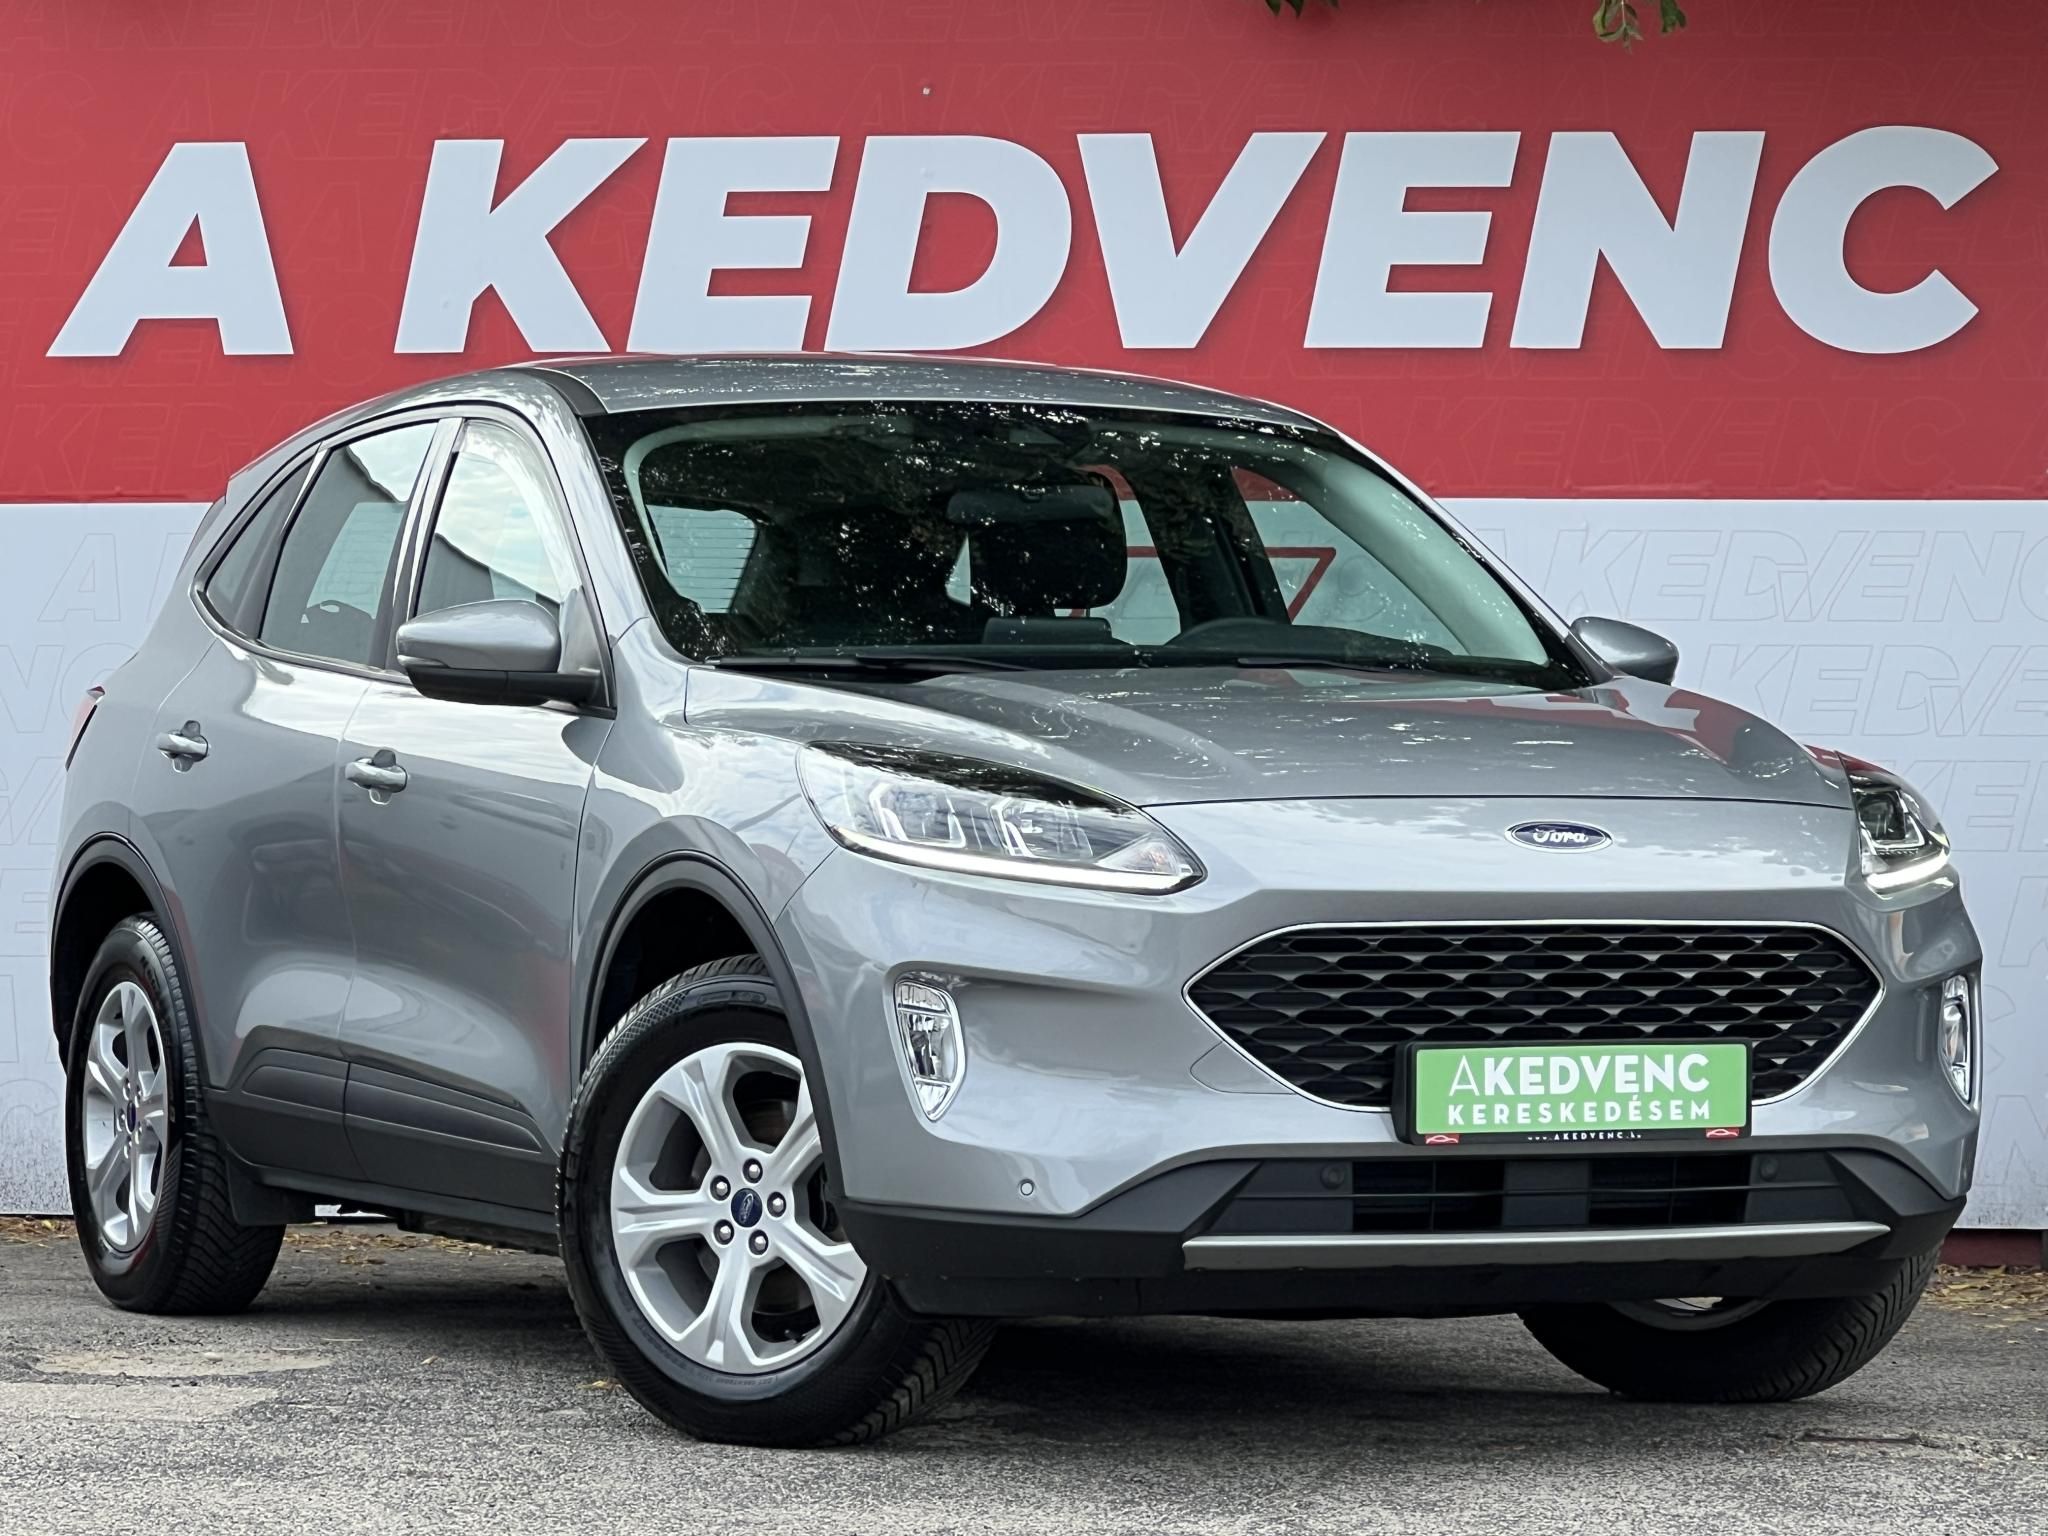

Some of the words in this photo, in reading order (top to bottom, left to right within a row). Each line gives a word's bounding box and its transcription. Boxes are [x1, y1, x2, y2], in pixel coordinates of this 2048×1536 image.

[47, 141, 294, 357] A
[394, 125, 2000, 355] KEDVENC
[37, 532, 121, 622] A
[1532, 828, 1589, 843] Ford
[1448, 1095, 1711, 1126] KERESKEDÉSEM
